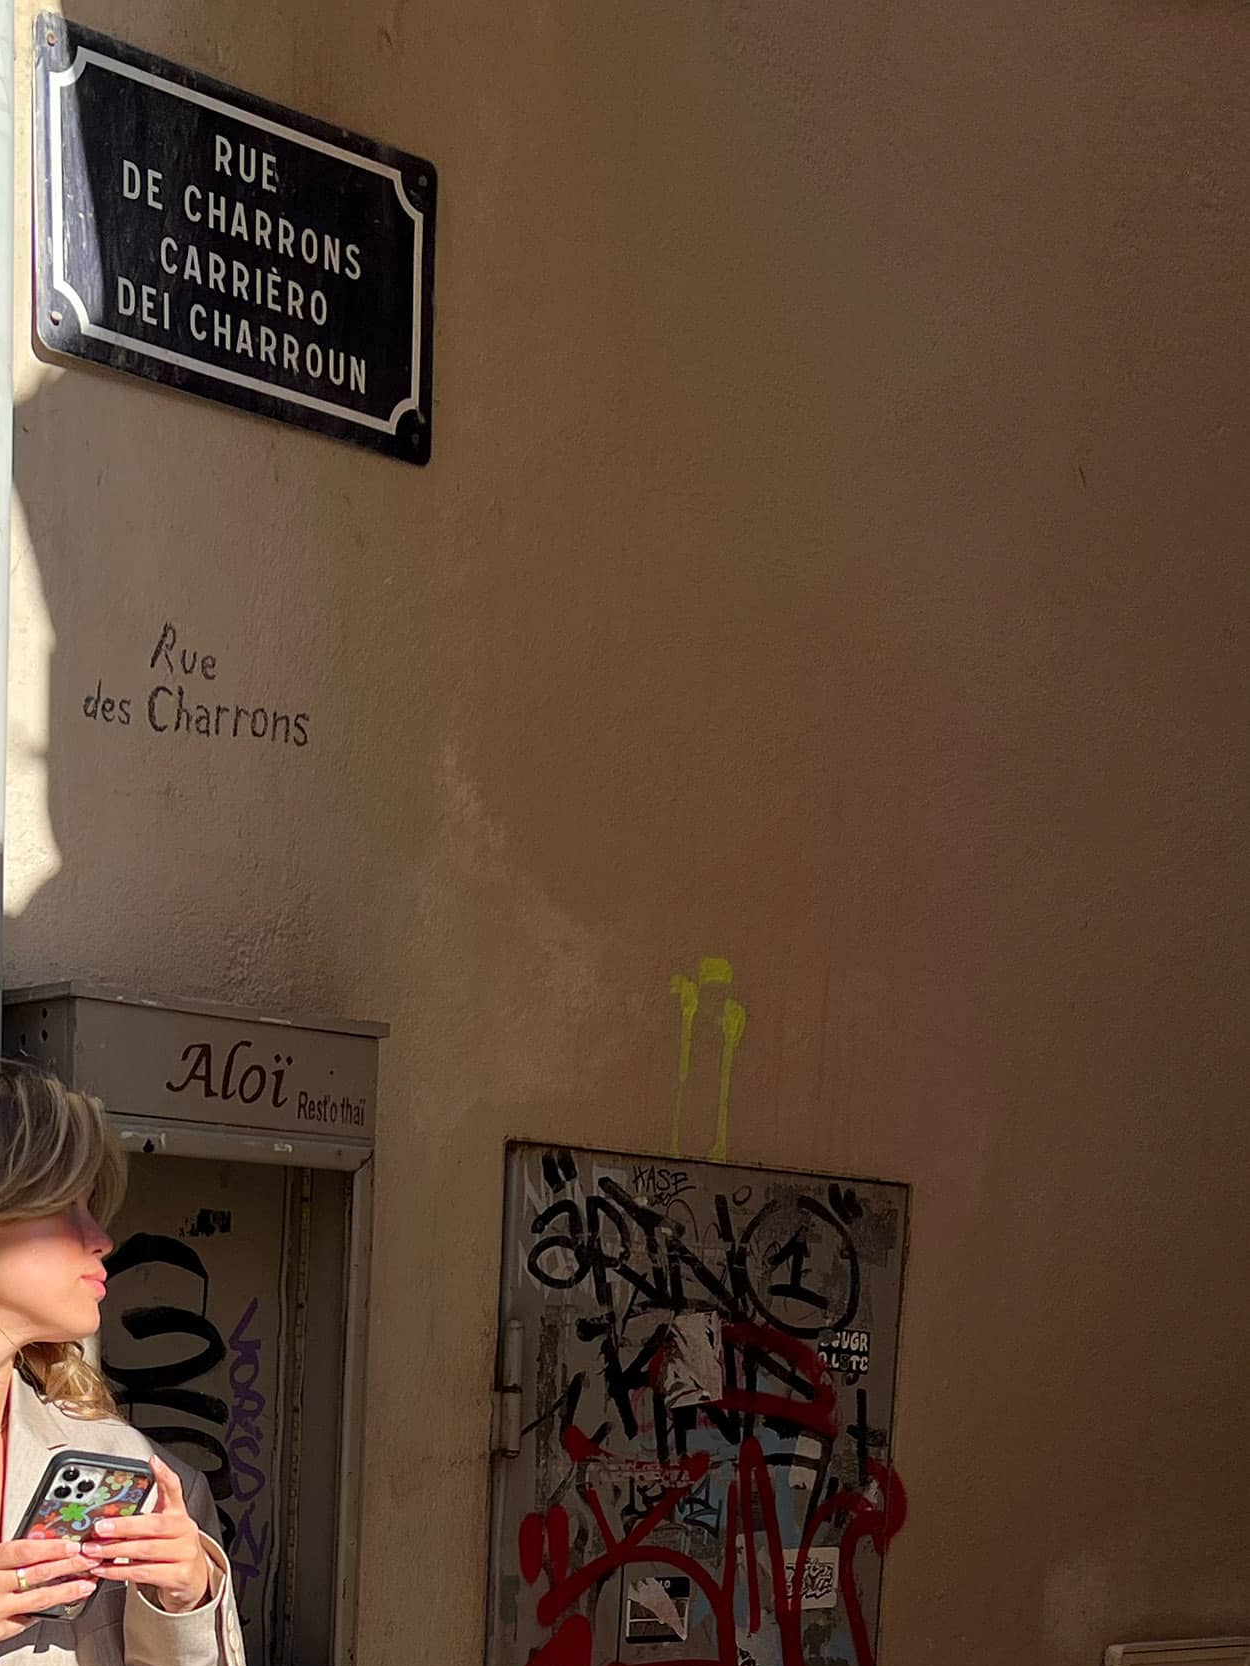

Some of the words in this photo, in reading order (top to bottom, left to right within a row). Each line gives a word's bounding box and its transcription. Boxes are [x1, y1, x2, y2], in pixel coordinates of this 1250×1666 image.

[215, 134, 278, 194] RUE
[122, 159, 164, 211] DE
[184, 184, 362, 281] CHARRONS
[160, 236, 328, 326] CARRIÈRO
[117, 276, 170, 330] DEI
[189, 303, 367, 395] CHARROUN
[149, 620, 217, 681] Rue
[82, 679, 131, 725] des
[147, 685, 311, 748] Charrons
[165, 1039, 294, 1109] Aloï
